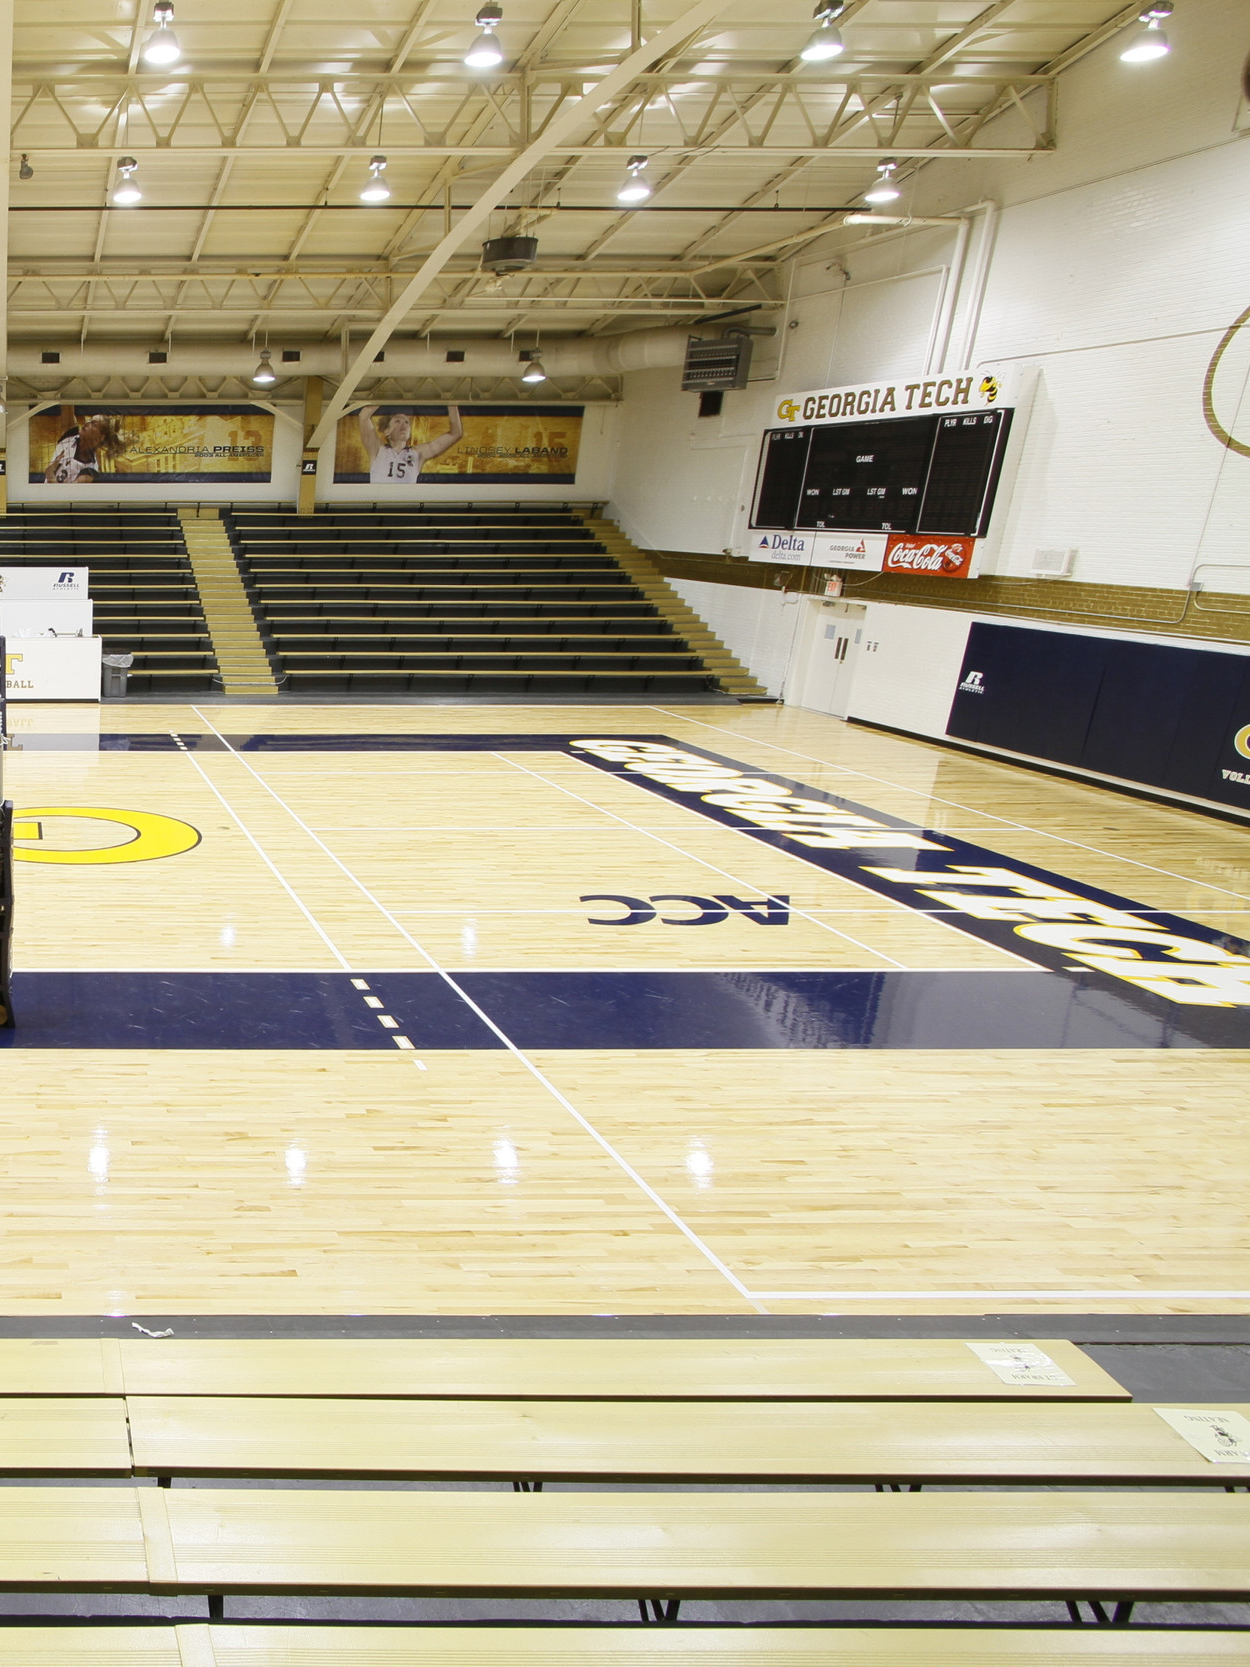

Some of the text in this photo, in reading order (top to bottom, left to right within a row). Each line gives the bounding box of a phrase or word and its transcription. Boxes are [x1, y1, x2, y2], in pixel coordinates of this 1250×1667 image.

[777, 376, 973, 422] GT GEORGIA TECH
[962, 416, 977, 425] KILLS
[855, 454, 874, 463] GAME
[388, 462, 407, 478] 15
[806, 488, 820, 496] WON
[902, 487, 918, 495] WON
[881, 522, 892, 530] TOL
[771, 534, 805, 552] Delta
[829, 544, 855, 552] GEORGIA
[771, 550, 801, 561] delta.com
[845, 552, 866, 560] POWER
[965, 671, 983, 685] R
[569, 739, 1250, 1008] GEORGIA TECH
[579, 894, 790, 926] ACC
